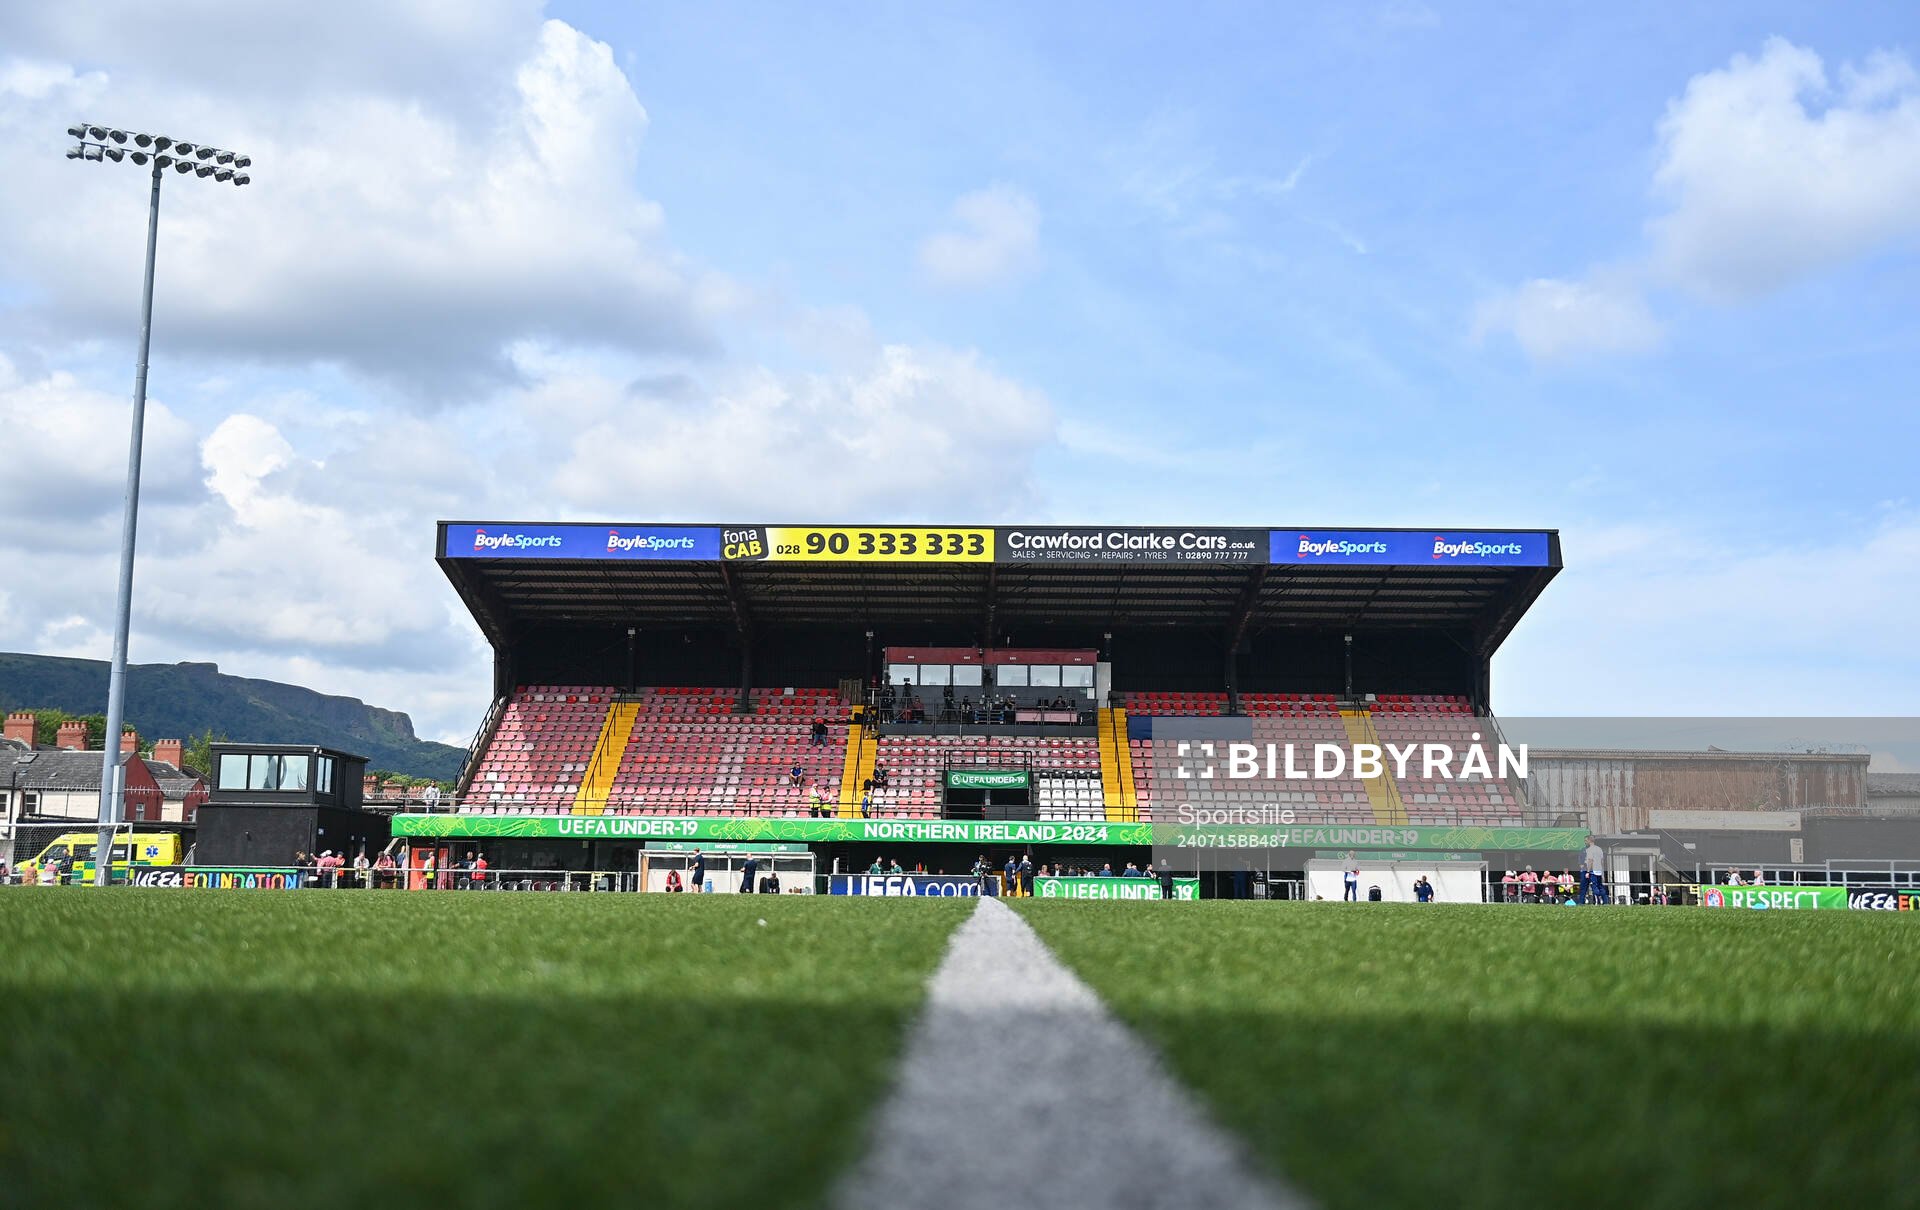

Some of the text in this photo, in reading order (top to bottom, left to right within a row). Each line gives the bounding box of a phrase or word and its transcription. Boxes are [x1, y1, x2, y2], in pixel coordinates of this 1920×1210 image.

[475, 534, 562, 550] BoyleSports
[607, 535, 695, 551] BoyleSports
[723, 529, 758, 545] fona
[776, 532, 985, 556] 028 90 333 333
[1007, 531, 1103, 549] Crawford
[1106, 532, 1176, 550] Clarke
[1179, 532, 1227, 550] Cars
[723, 540, 762, 560] CAB
[1012, 550, 1248, 560] SALES SERVICING REPAIRS TYRES T: 02890 777 777
[1298, 540, 1387, 556] BoyleSports
[1433, 541, 1522, 557] BoyleSports
[962, 776, 1026, 784] UEFA UNDER-19
[558, 819, 699, 836] UEFA UNDER-19
[864, 823, 1108, 841] NORTHERN IRELAND 2024
[1276, 828, 1419, 845] UEFA UNDER-19
[1065, 883, 1109, 900] UEFA
[1732, 891, 1821, 909] RESPECT
